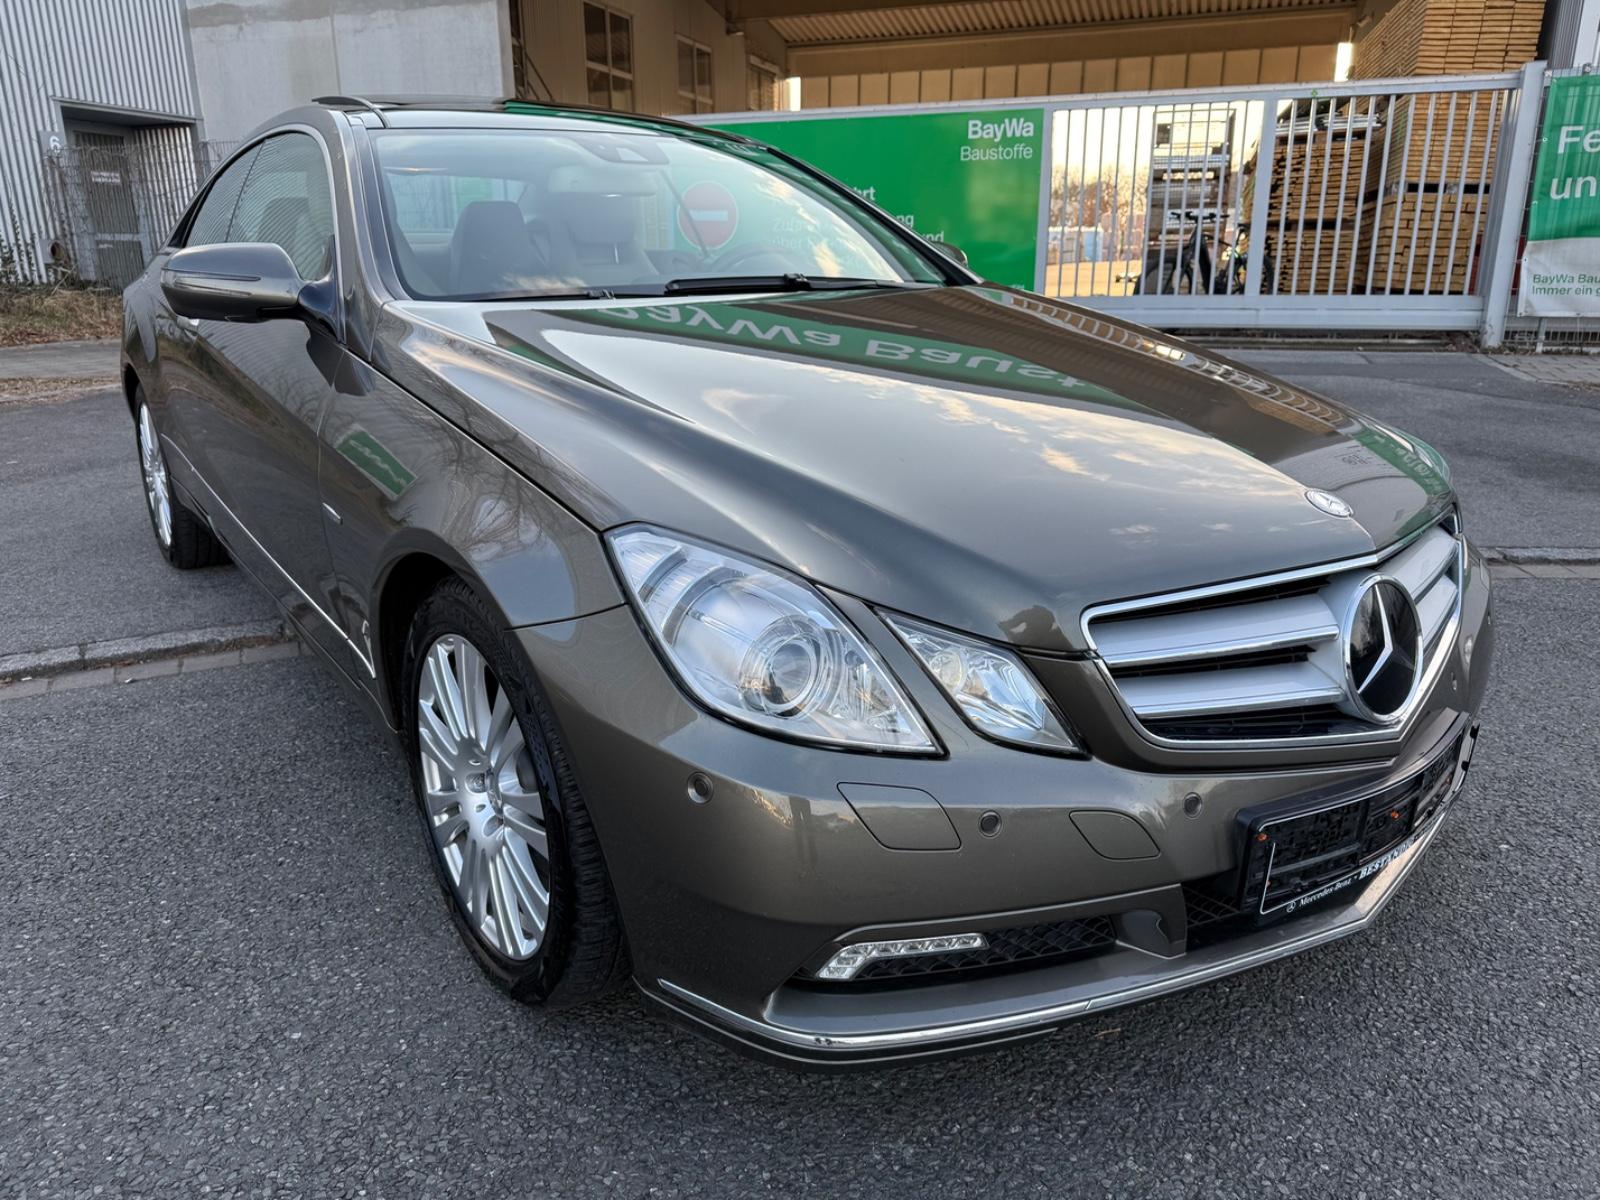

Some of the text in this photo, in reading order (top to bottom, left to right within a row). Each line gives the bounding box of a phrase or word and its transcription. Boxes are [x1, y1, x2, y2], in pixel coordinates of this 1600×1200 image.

[968, 117, 1034, 142] BayWa
[960, 143, 1033, 161] Baustoffe
[1533, 274, 1575, 285] BayWa
[1532, 286, 1572, 296] Immer
[1575, 285, 1593, 295] ein
[1299, 878, 1352, 907] Mercedes-Benz
